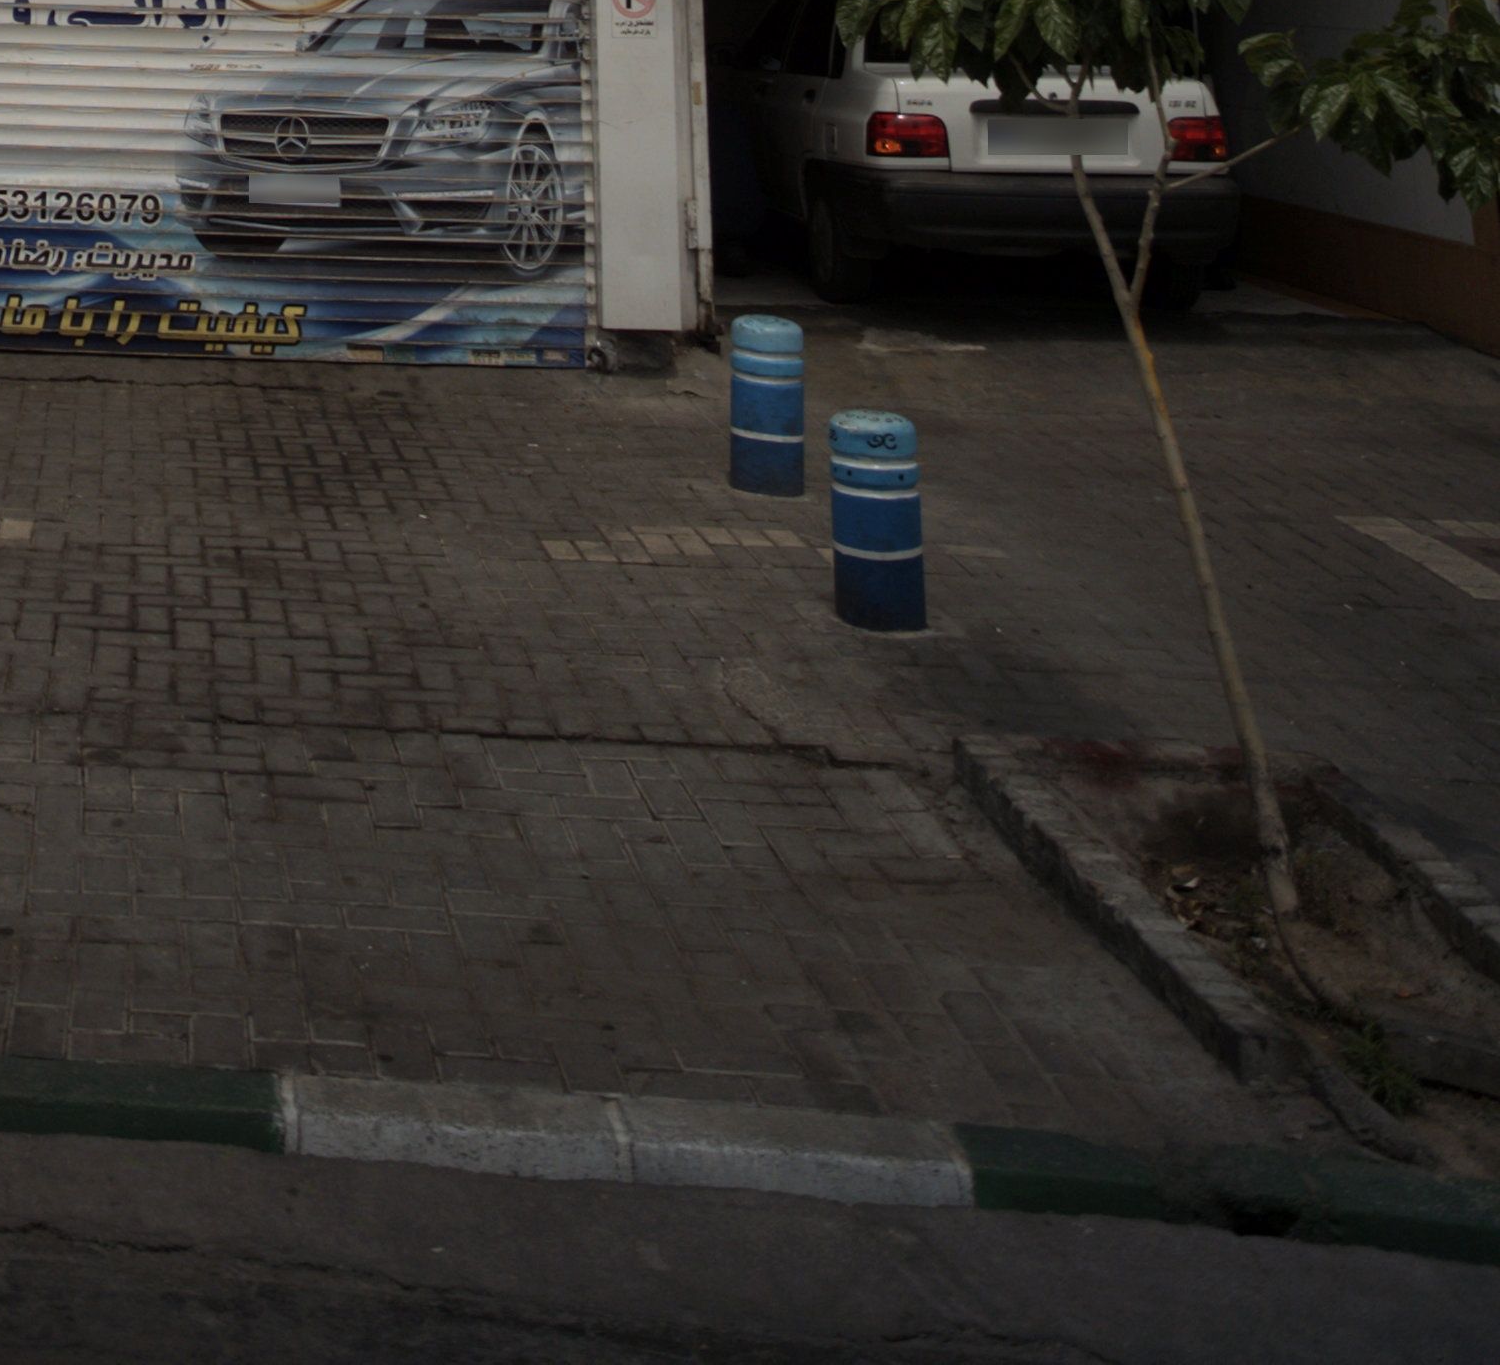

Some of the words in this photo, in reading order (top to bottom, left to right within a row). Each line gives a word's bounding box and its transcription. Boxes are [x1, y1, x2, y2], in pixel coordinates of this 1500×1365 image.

[9, 238, 68, 273] رضا
[0, 294, 50, 335] ما
[59, 296, 97, 347] با
[105, 298, 145, 346] را
[158, 299, 307, 354] کیفیت
